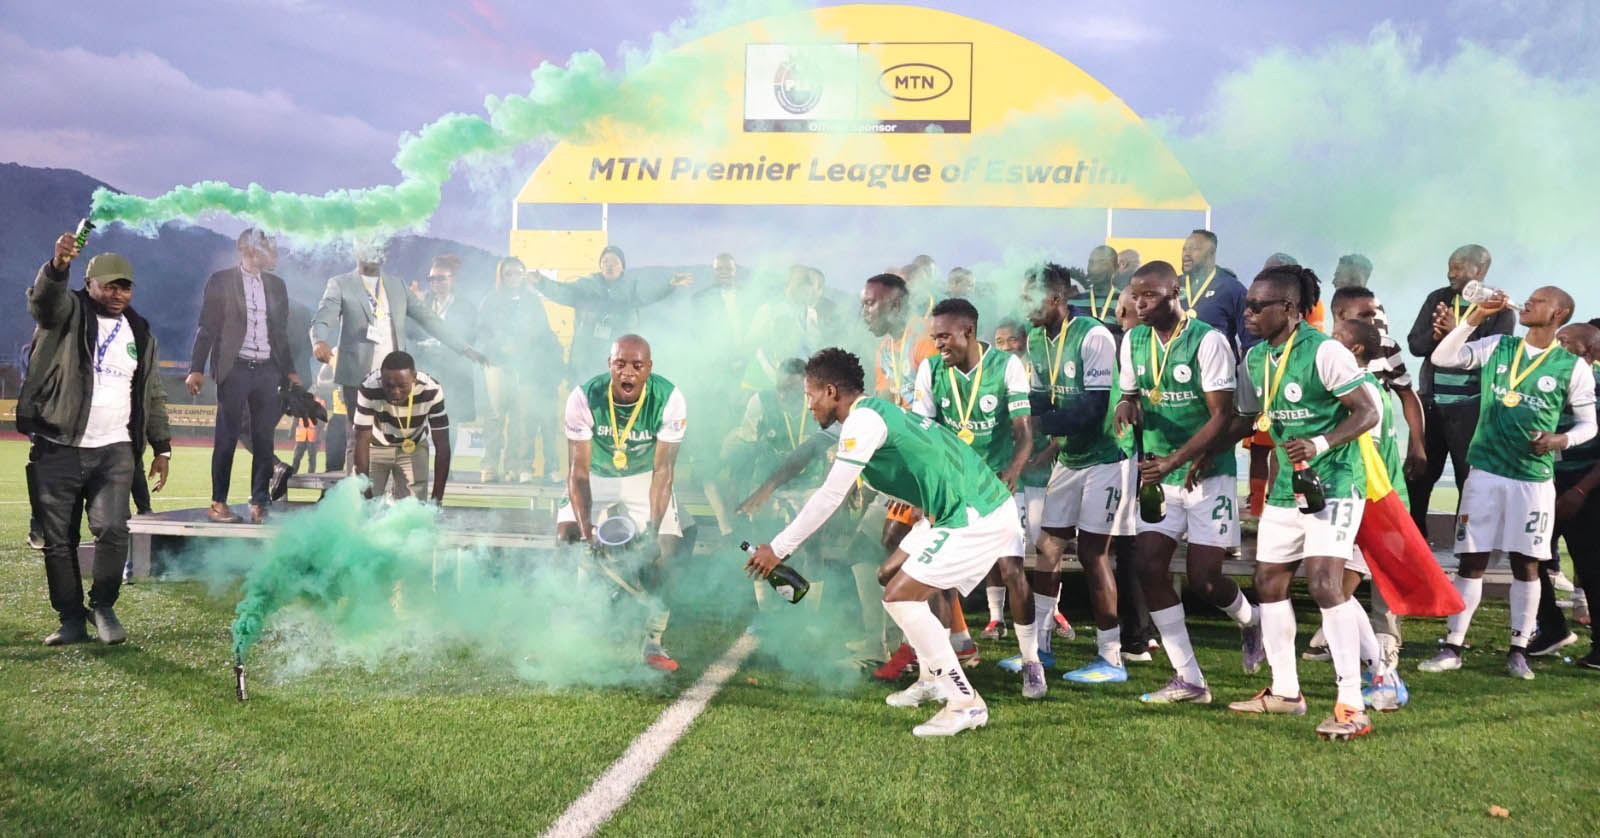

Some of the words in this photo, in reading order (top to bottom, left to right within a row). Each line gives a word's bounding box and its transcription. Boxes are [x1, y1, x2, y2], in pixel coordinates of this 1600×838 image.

[895, 75, 934, 89] MTN
[589, 157, 662, 181] MTN
[671, 156, 800, 181] Premier
[808, 157, 930, 189] League
[941, 156, 979, 183] of
[1328, 501, 1353, 528] 13
[1525, 511, 1548, 533] 20
[925, 530, 950, 555] 3
